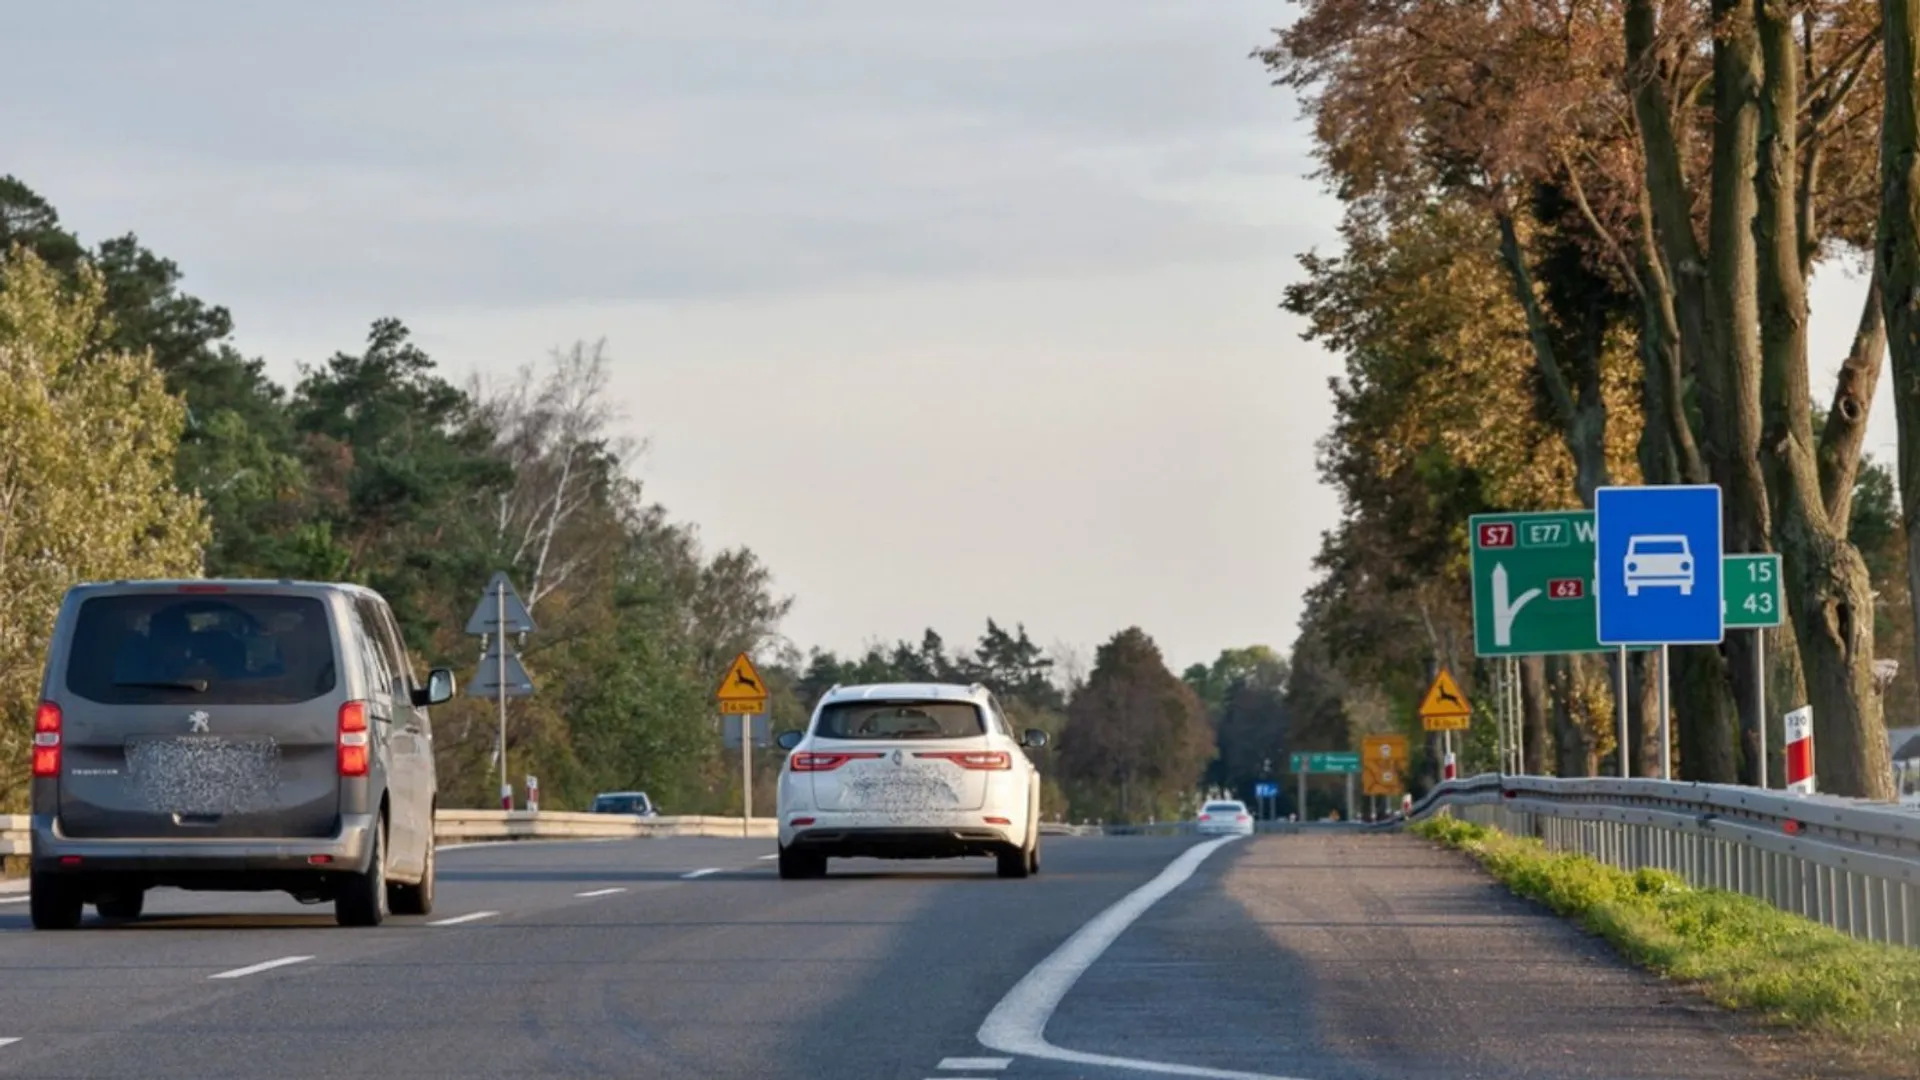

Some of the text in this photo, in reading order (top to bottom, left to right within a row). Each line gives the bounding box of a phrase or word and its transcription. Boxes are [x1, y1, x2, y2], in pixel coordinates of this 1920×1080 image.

[1487, 521, 1597, 545] S7 E77 W
[1747, 561, 1772, 582] 15
[1556, 582, 1577, 596] 62
[1742, 592, 1773, 614] 43
